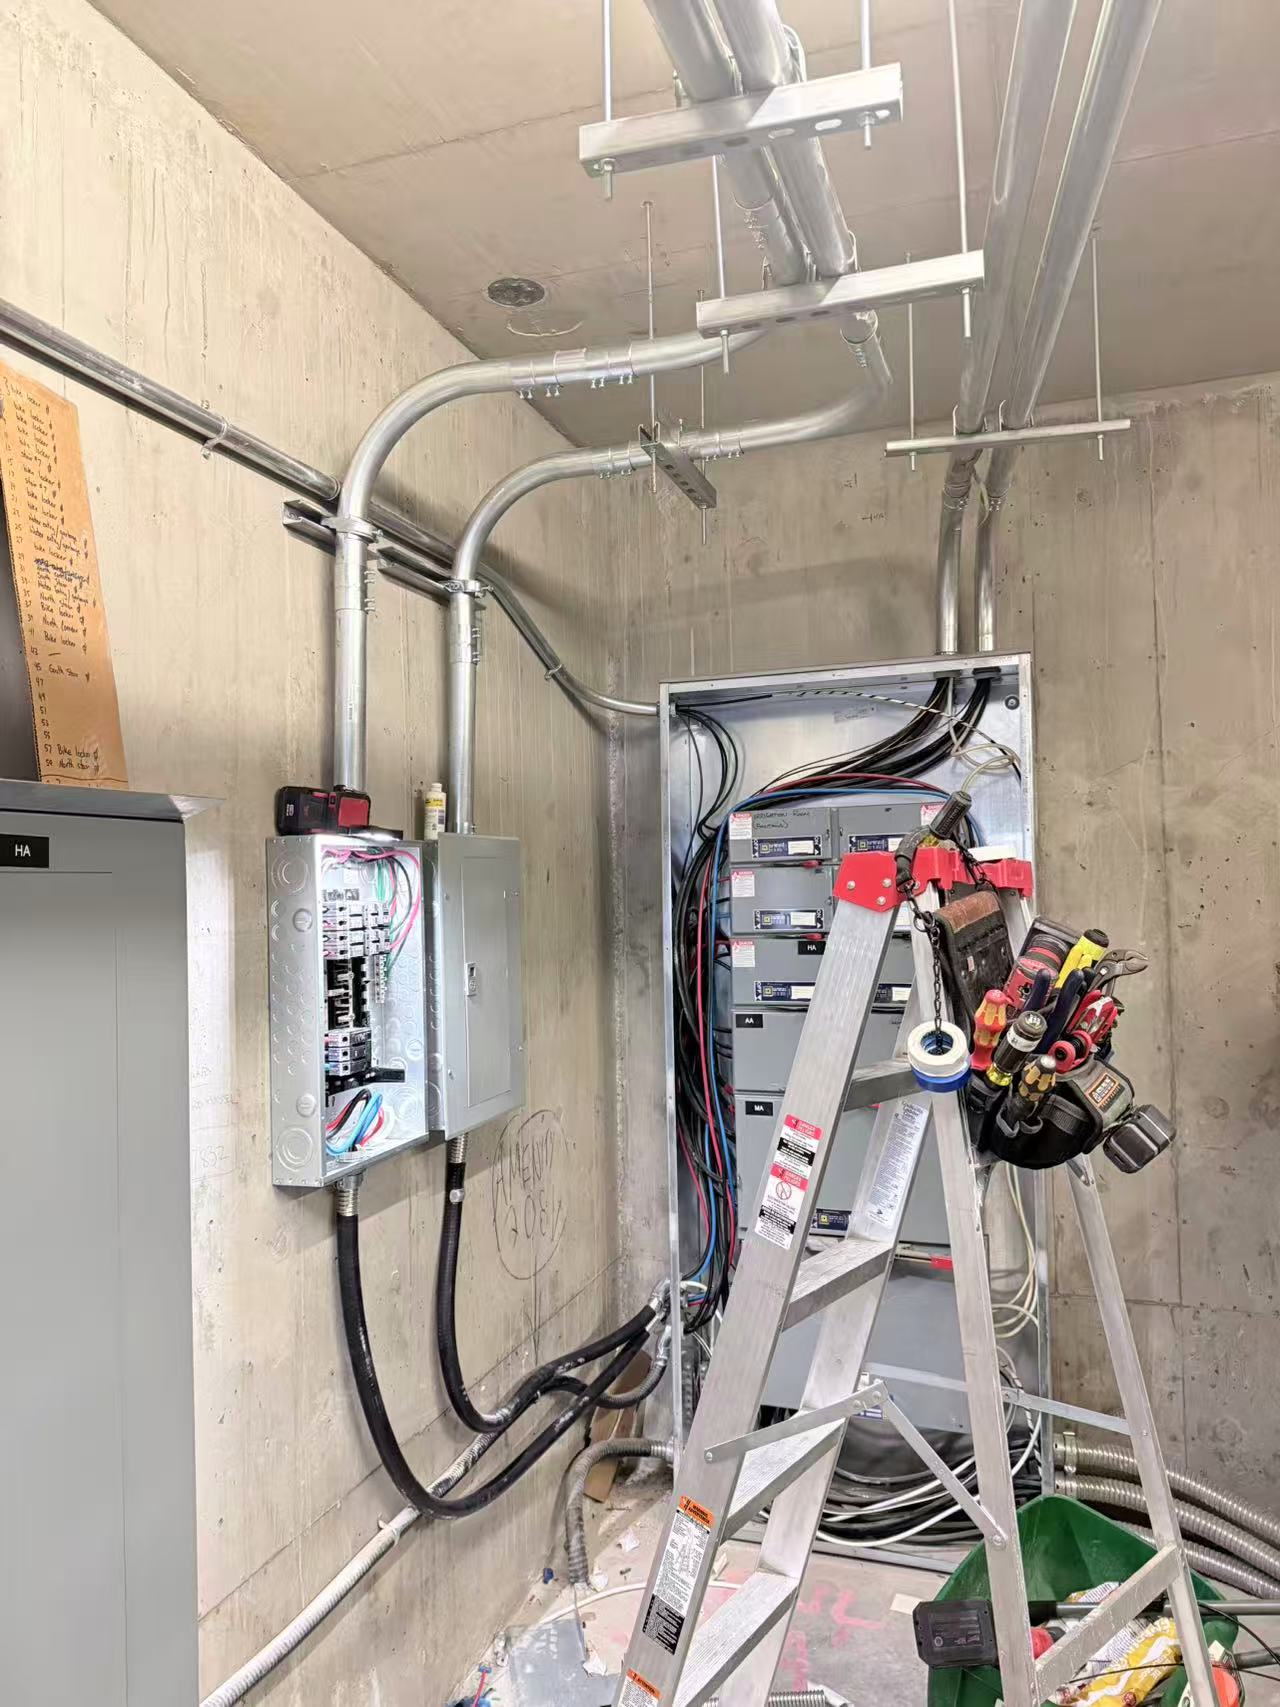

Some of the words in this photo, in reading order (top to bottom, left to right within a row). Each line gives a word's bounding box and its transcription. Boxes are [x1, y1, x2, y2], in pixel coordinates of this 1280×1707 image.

[36, 677, 43, 686] 47
[44, 744, 51, 754] 57
[57, 744, 72, 756] Bike
[15, 844, 31, 857] HA
